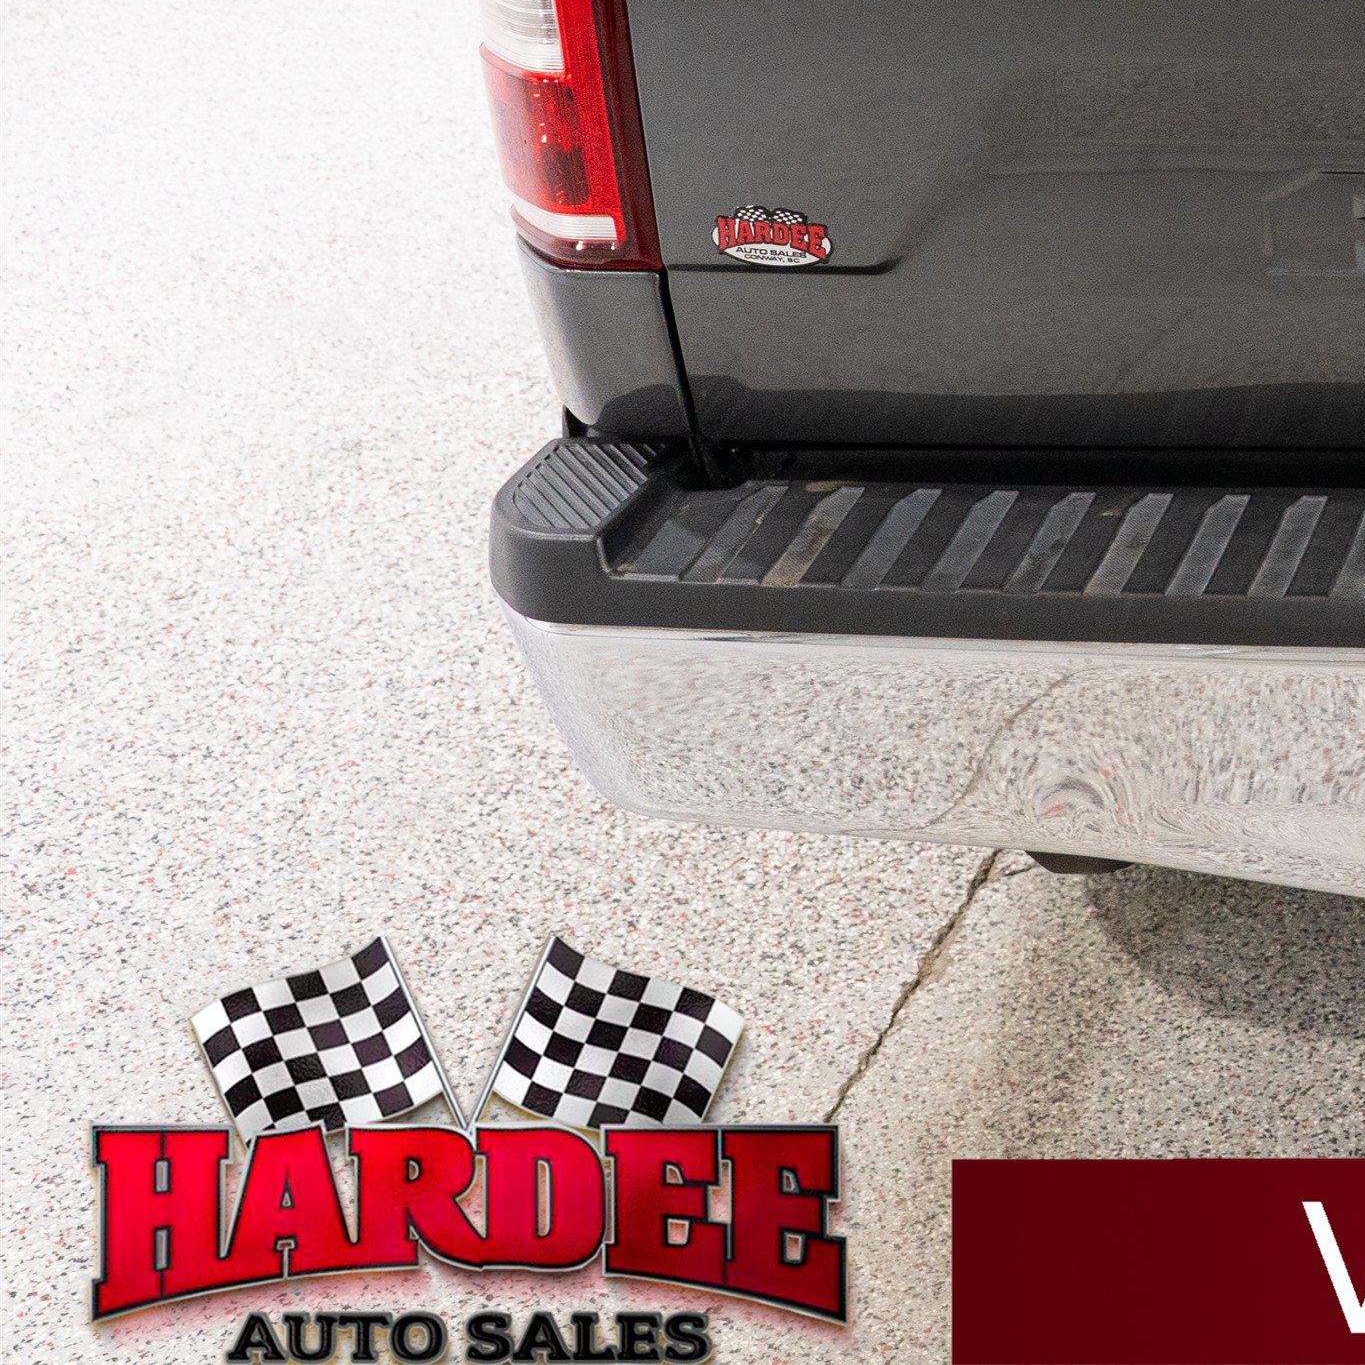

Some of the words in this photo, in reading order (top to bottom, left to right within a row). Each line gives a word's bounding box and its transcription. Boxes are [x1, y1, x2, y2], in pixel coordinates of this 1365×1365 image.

[717, 217, 827, 260] HARDEE
[736, 246, 768, 255] AUTO
[770, 249, 807, 259] SALES
[744, 253, 784, 263] CONWAY,
